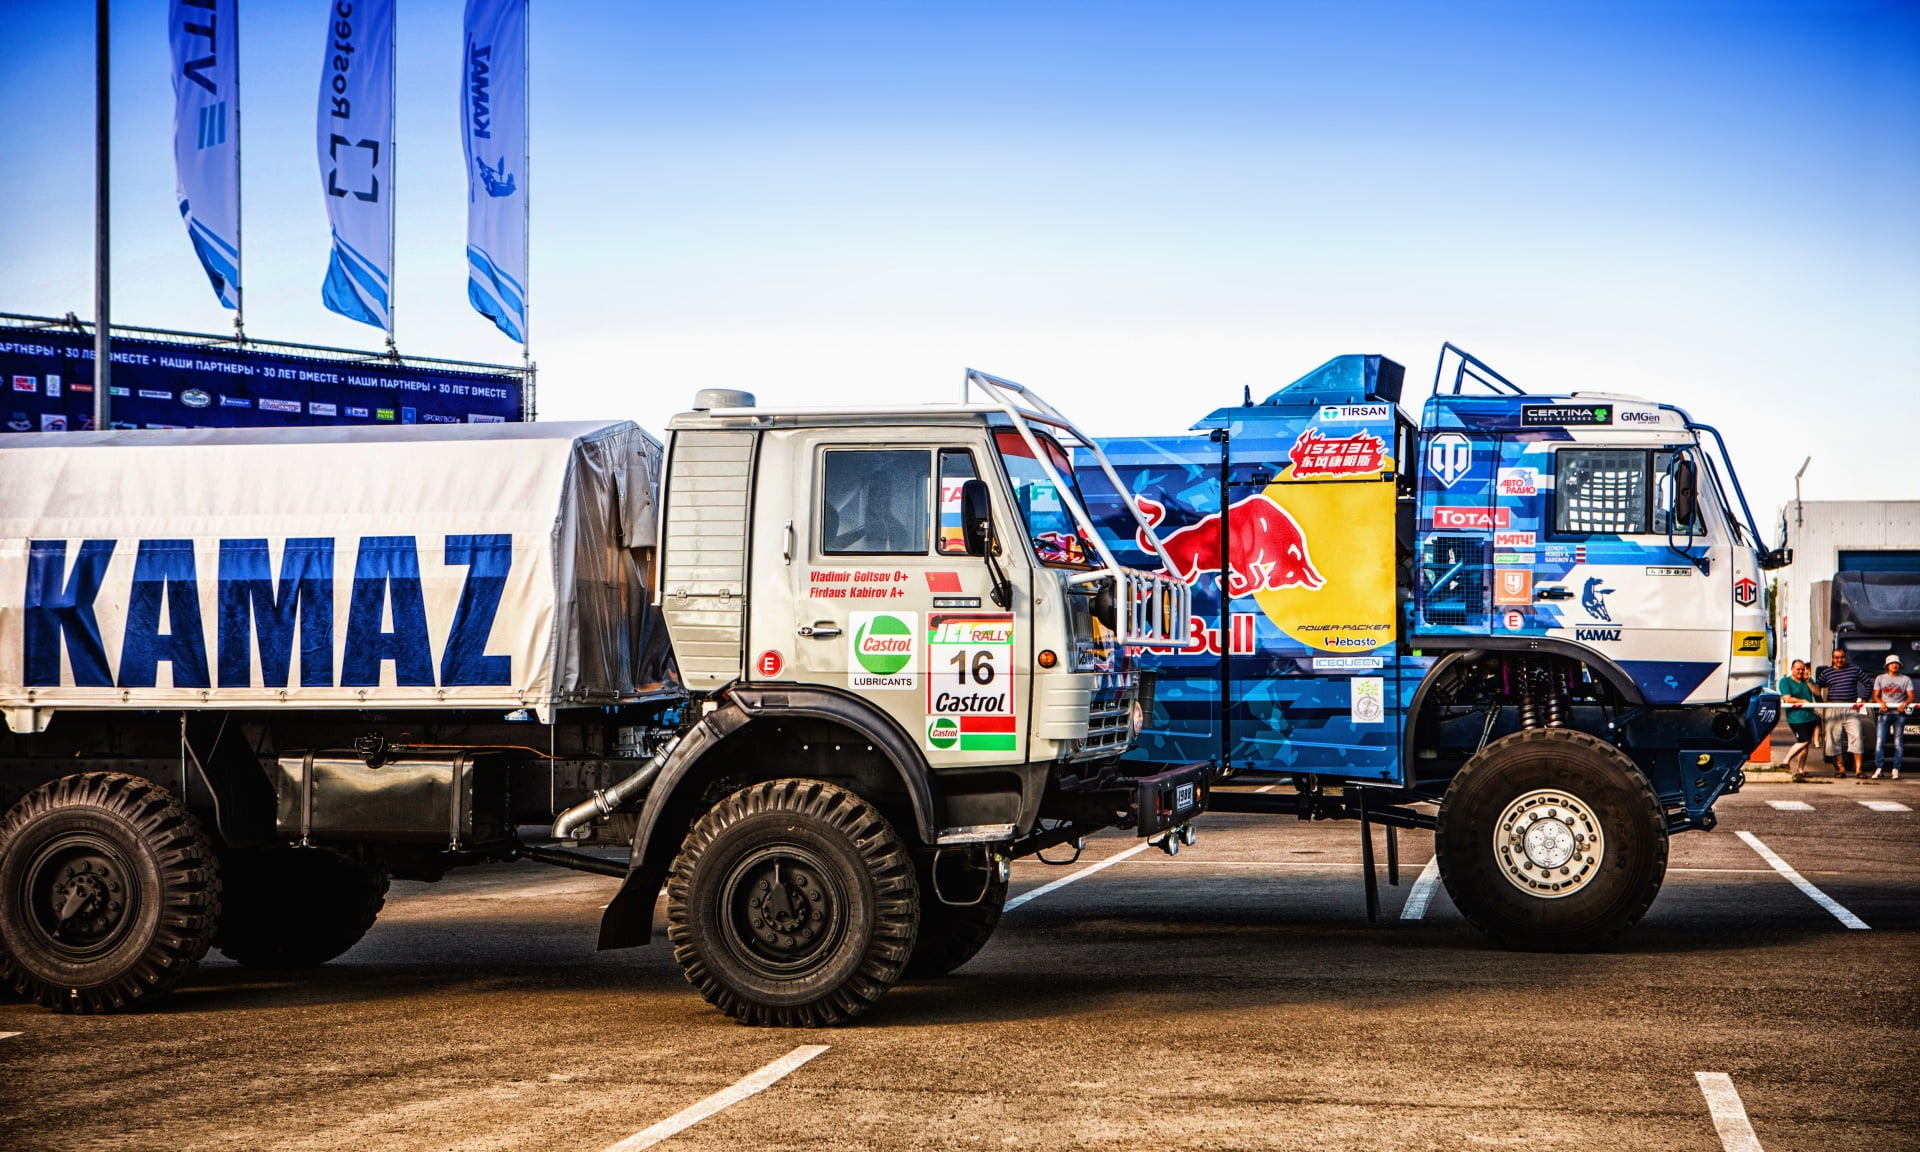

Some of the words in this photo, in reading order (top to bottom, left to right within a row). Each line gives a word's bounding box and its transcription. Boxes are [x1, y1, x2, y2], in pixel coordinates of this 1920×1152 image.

[0, 342, 54, 356] АРТНЕРЫ
[65, 347, 80, 358] 30
[82, 349, 96, 360] ЛЕ
[160, 357, 193, 370] НАШИ
[196, 360, 254, 375] ПАРТНЕРЫ
[263, 367, 276, 378] 30
[277, 369, 297, 380] ЛЕТ
[299, 371, 339, 384] ВМЕСТЕ
[348, 375, 378, 388] НАШИ
[380, 378, 431, 392] ПАРТНЕРЫ
[439, 383, 451, 393] 30
[452, 384, 469, 395] ЛЕТ
[471, 387, 507, 399] ВМЕСТЕ
[1527, 408, 1592, 417] CERTINA
[1621, 412, 1660, 422] GMGen
[1304, 442, 1375, 454] ISZ13L
[1437, 510, 1507, 525] TOTAL
[810, 571, 851, 583] Vladimir
[853, 571, 891, 582] Goltsov
[809, 587, 846, 598] Firdaus
[849, 587, 887, 598] Kabirov
[890, 588, 905, 598] A+
[23, 533, 513, 688] KAMAZ
[1509, 616, 1518, 626] E
[971, 630, 1014, 641] RALLY
[1576, 629, 1622, 641] KAMAZ
[863, 637, 912, 652] Castrol
[1325, 636, 1377, 647] Webasto
[764, 657, 774, 671] E
[950, 650, 995, 686] 16
[1315, 658, 1380, 667] ICEQUEEN
[854, 677, 912, 686] LUBRICANTS
[935, 692, 1006, 712] Castrol
[932, 729, 958, 738] Castrol
